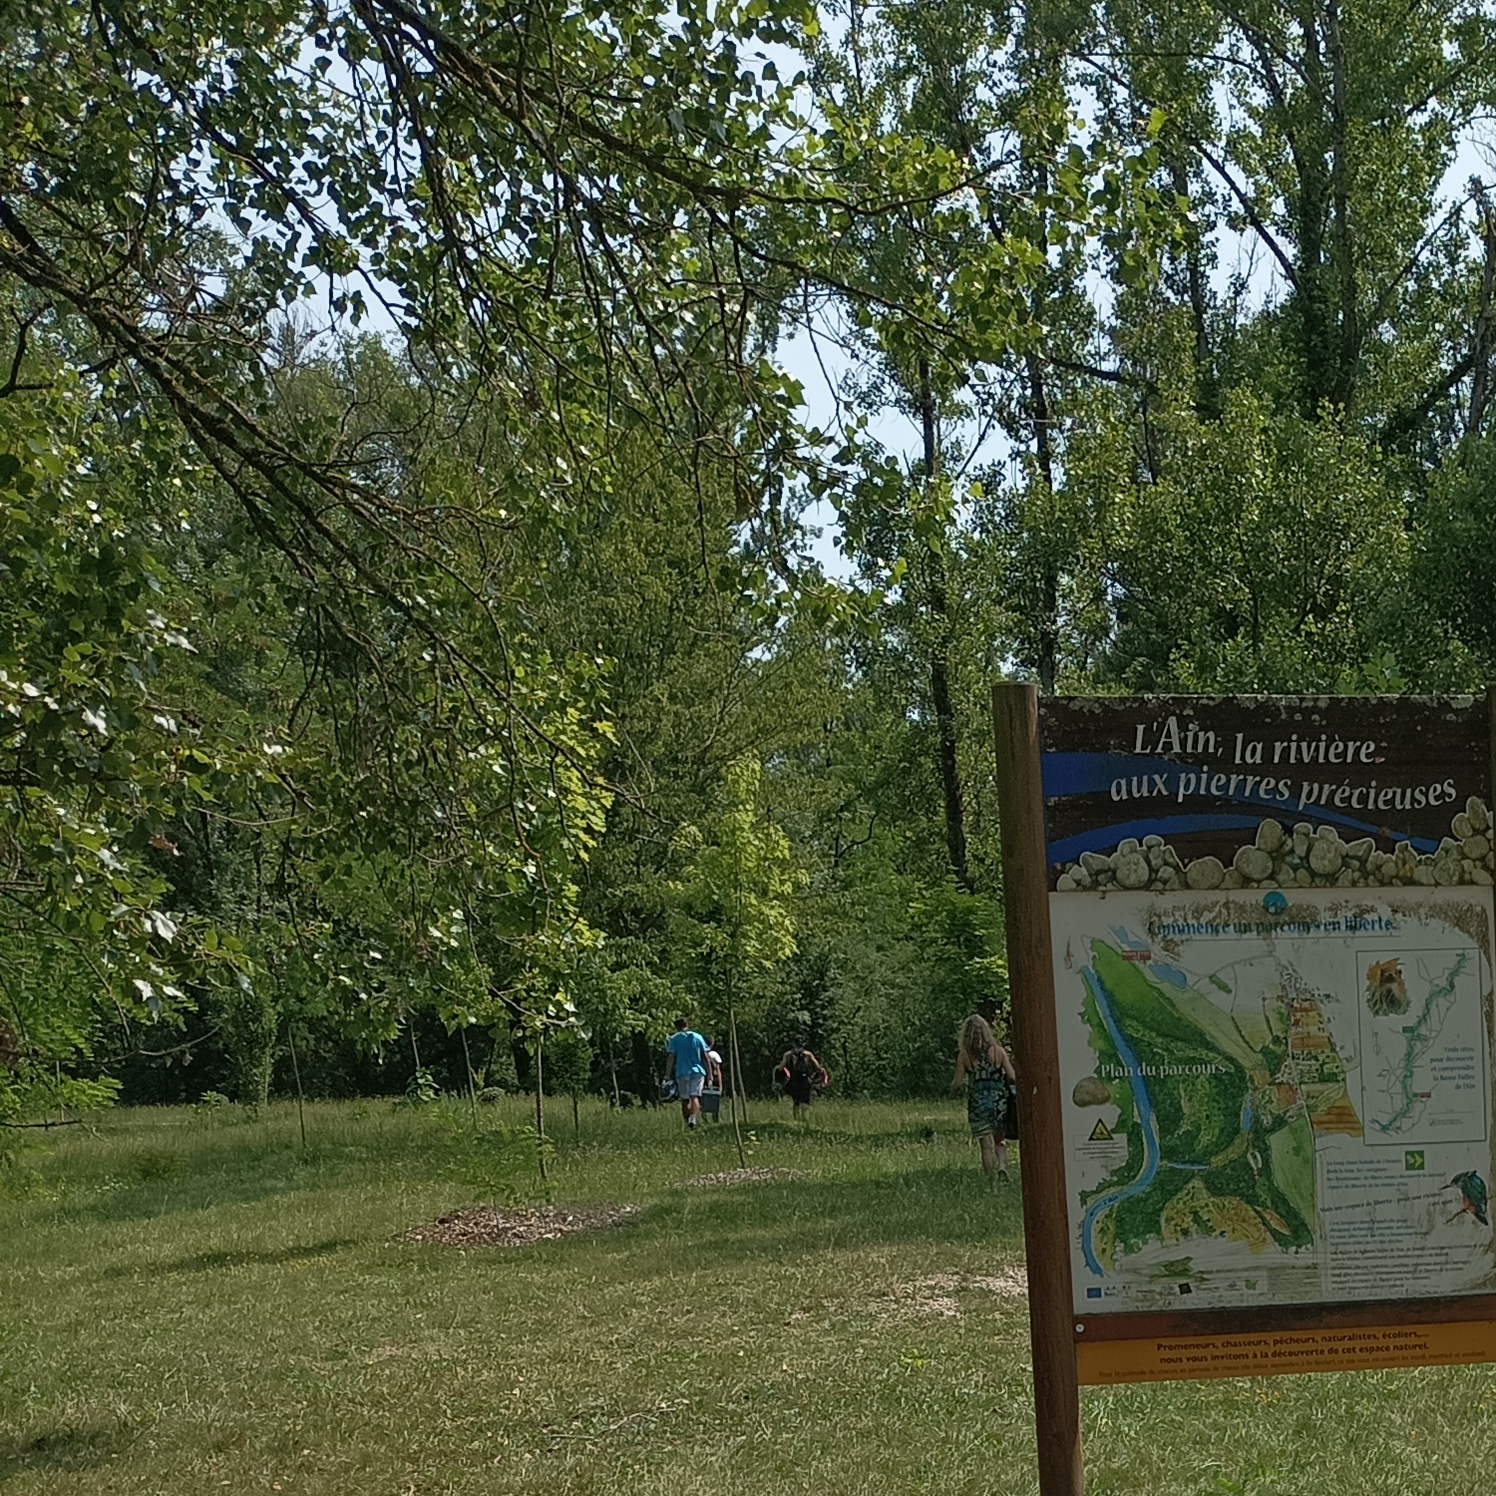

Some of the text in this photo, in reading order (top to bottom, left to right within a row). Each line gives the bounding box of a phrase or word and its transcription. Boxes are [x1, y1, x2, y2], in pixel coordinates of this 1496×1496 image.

[1234, 733, 1263, 764] la
[1110, 765, 1457, 811] aux pierres précieuses
[1324, 919, 1341, 932] en
[1100, 1061, 1226, 1078] Plan du parcours
[1156, 1341, 1219, 1352] Promeneurs,
[1221, 1337, 1271, 1349] chasseurs,
[1273, 1335, 1319, 1347] pêcheurs,
[1321, 1332, 1380, 1344] naturalistes,
[1159, 1338, 1429, 1365] nous vous invitons à la découverte de cet espace naturel.
